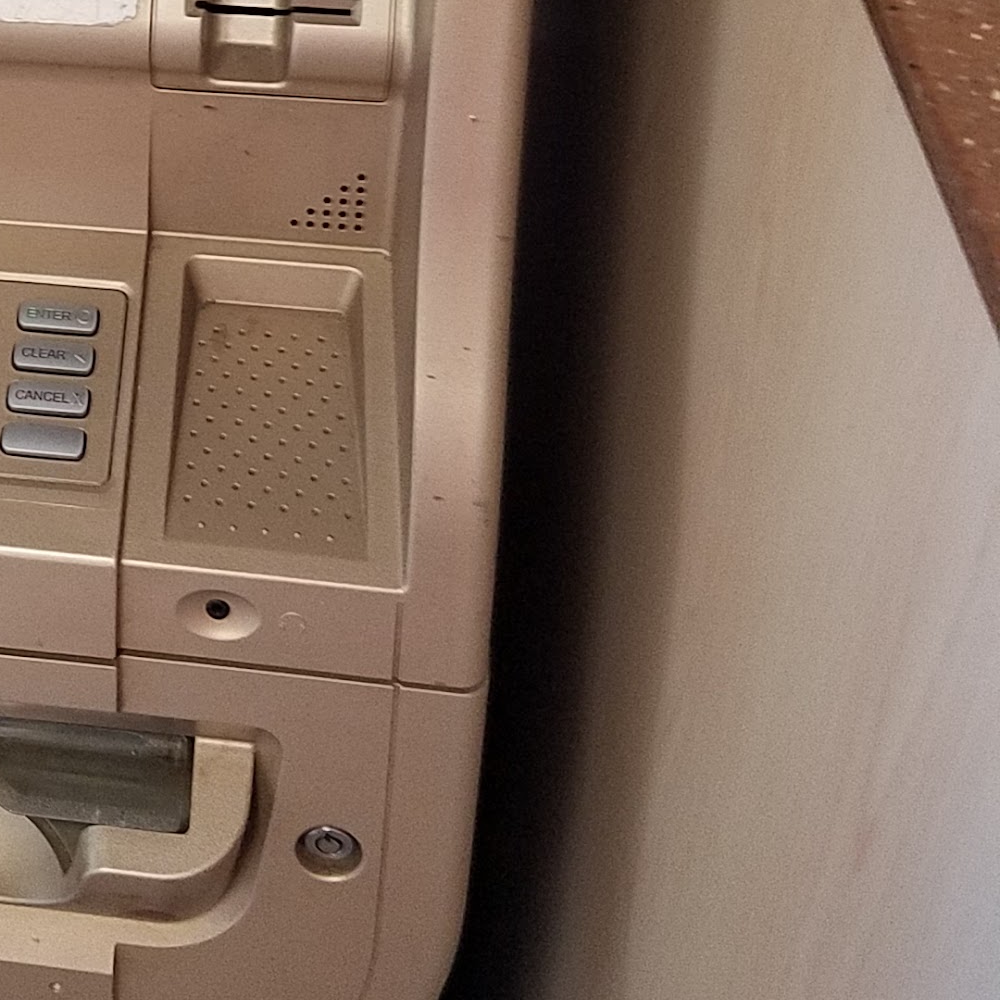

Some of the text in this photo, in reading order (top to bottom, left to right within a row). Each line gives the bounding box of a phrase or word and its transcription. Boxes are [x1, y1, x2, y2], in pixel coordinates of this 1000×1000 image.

[26, 306, 71, 321] ENTER
[21, 346, 66, 360] CLEAR
[15, 388, 69, 404] CANCEL
